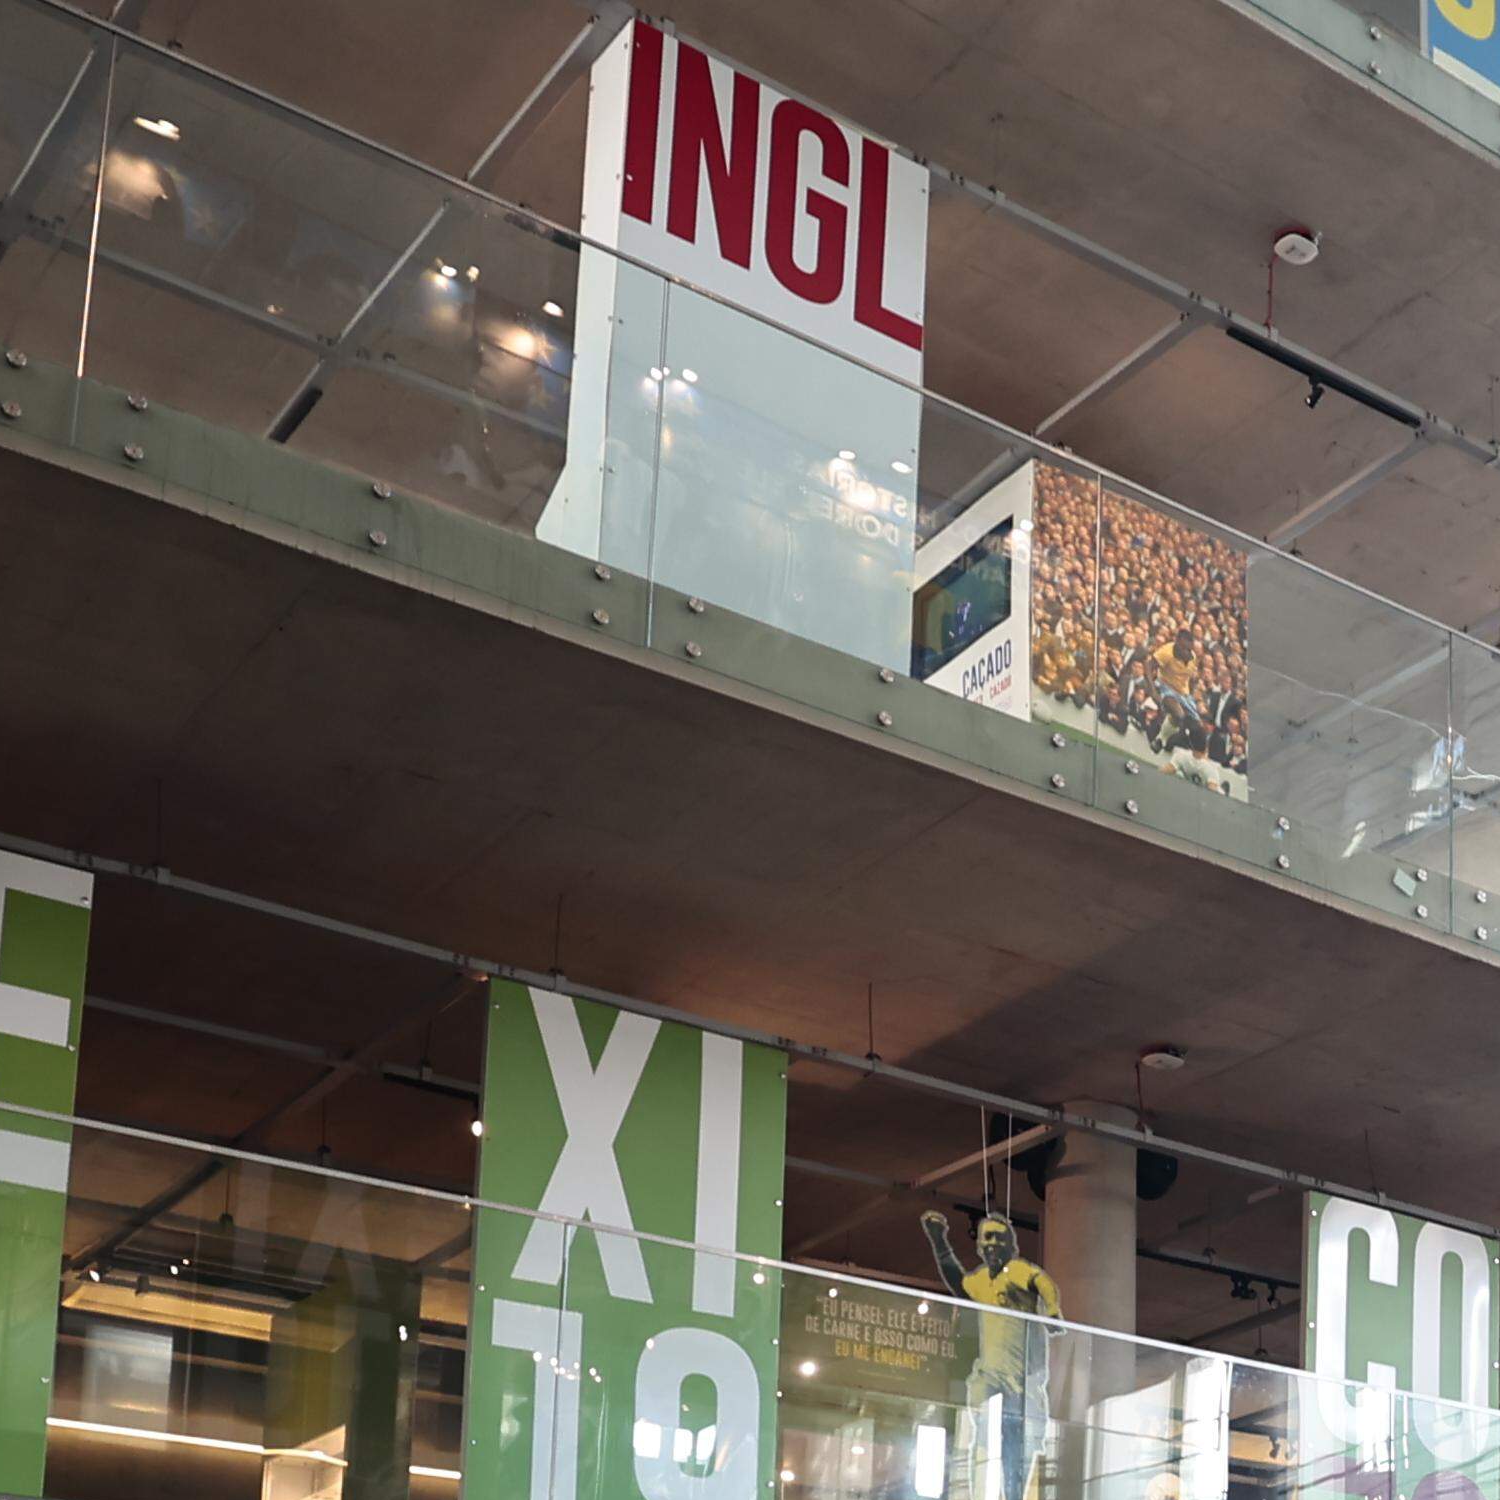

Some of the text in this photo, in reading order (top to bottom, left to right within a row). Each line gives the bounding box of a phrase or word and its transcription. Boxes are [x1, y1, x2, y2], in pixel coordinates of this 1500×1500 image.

[621, 20, 923, 350] INGL
[962, 638, 1012, 699] CAÇADO
[511, 986, 743, 1317] XI
[805, 1315, 820, 1333] DE
[823, 1319, 861, 1342] CARNE
[863, 1326, 871, 1343] E
[874, 1326, 904, 1349] OSSO
[907, 1333, 938, 1355] COMO
[834, 1339, 850, 1357] EU
[853, 1343, 870, 1361] ME
[887, 1309, 909, 1331] ELE
[1317, 1195, 1491, 1461] CO
